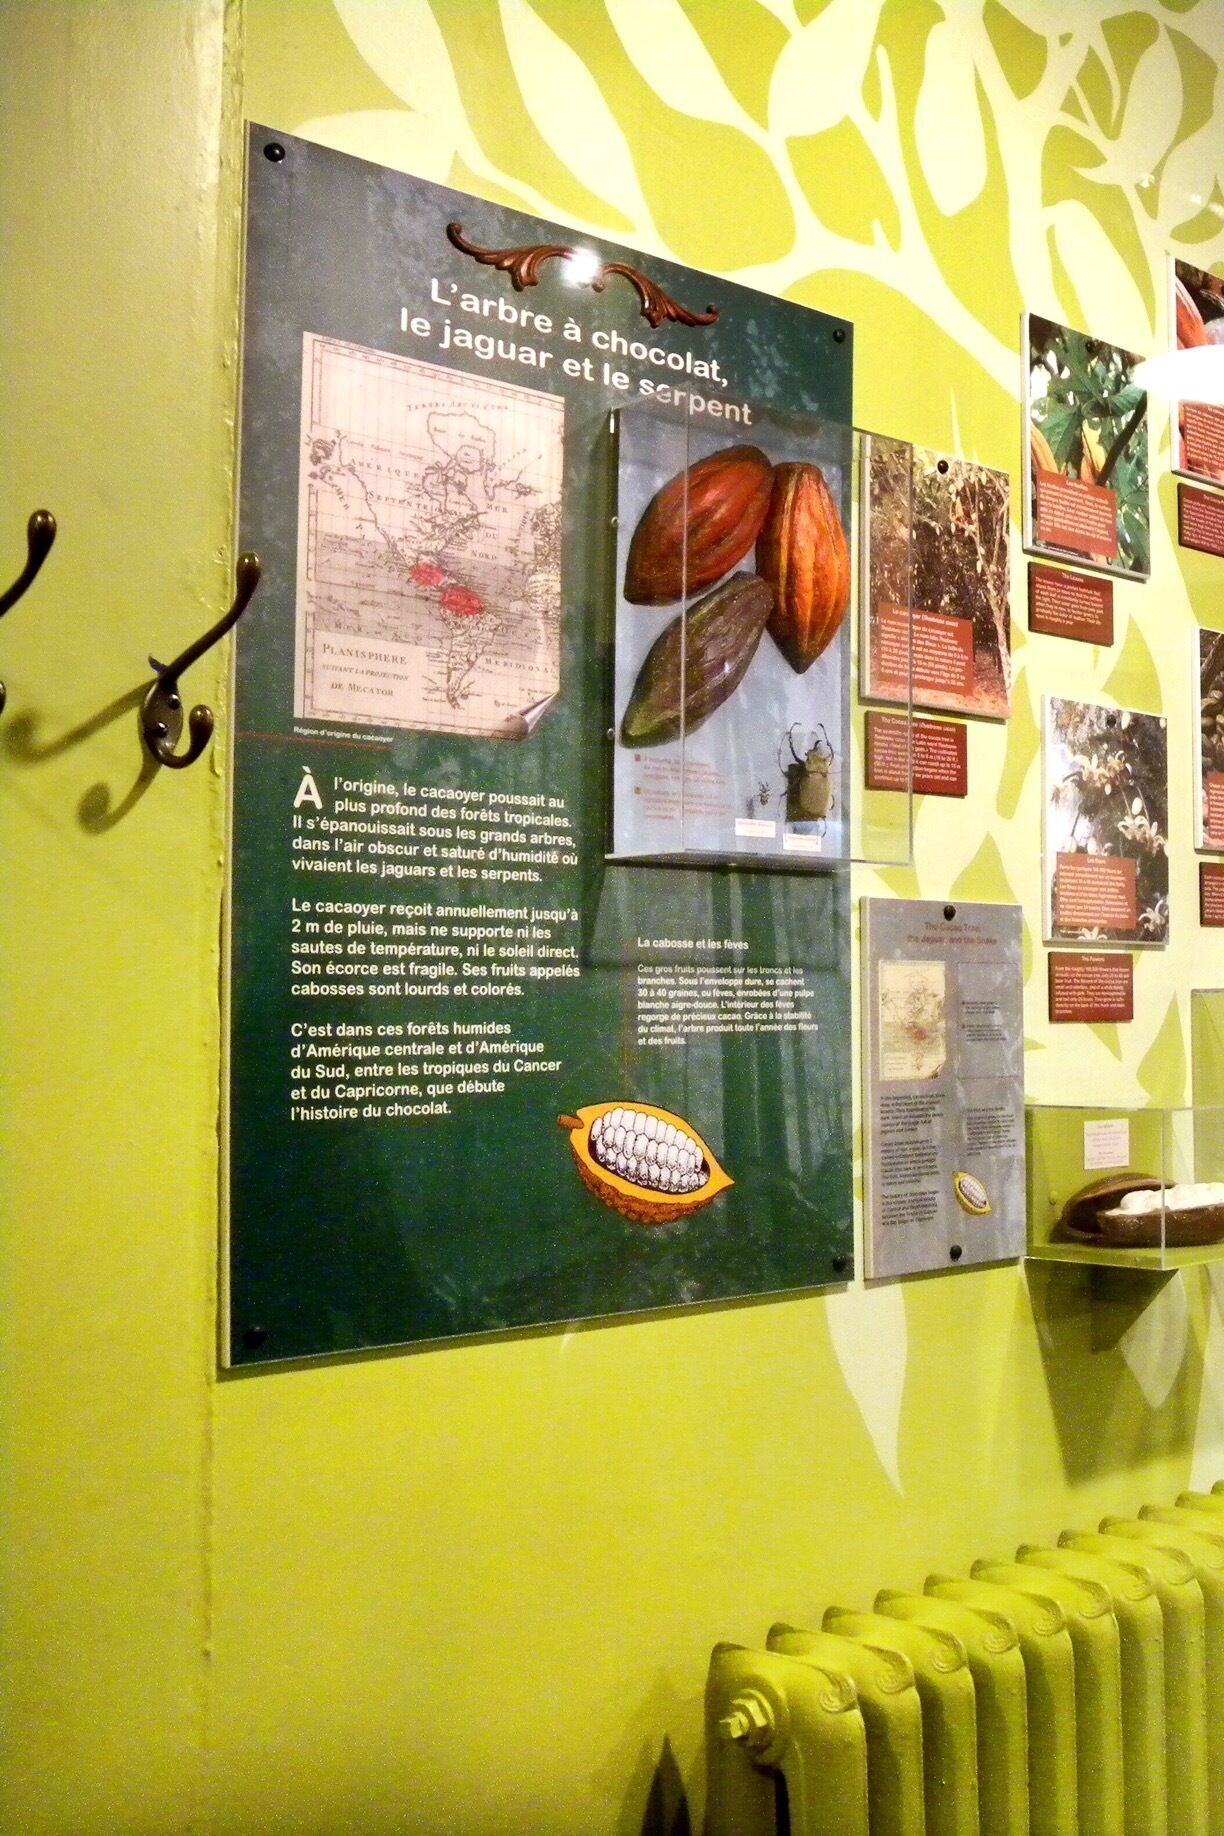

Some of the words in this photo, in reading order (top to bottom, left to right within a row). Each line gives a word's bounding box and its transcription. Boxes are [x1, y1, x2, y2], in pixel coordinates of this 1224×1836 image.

[430, 277, 552, 333] L'arbre
[562, 316, 581, 342] à
[592, 330, 728, 388] chocolat,
[400, 306, 430, 336] le
[439, 319, 552, 368] jaguar
[562, 357, 594, 382] et
[603, 363, 630, 390] le
[638, 380, 752, 425] serpent
[322, 643, 407, 664] PLANISPHERE
[294, 726, 318, 735] Région
[319, 729, 350, 738] d'origine
[362, 734, 393, 742] cacaoyer
[293, 766, 322, 810] À
[334, 776, 398, 797] l'origine,
[403, 782, 416, 796] le
[420, 787, 485, 803] cacaoyer
[488, 793, 545, 806] poussait
[548, 798, 564, 808] au
[334, 798, 366, 813] plus
[370, 802, 426, 816] profond
[431, 805, 456, 818] des
[460, 806, 500, 822] forêts
[504, 810, 572, 827] tropicales.
[292, 814, 302, 828] Il
[306, 816, 416, 835] s'épanouissait
[419, 826, 452, 838] sous
[455, 825, 476, 839] les
[480, 830, 526, 843] grands
[530, 832, 575, 848] arbres,
[292, 836, 330, 850] dans
[334, 838, 364, 852] l'air
[368, 840, 419, 855] obscur
[420, 844, 438, 856] et
[440, 845, 485, 860] saturé
[488, 847, 558, 863] d'humidité
[562, 852, 577, 864] où
[292, 856, 352, 872] vivaient
[356, 859, 377, 873] les
[380, 861, 435, 878] jaguars
[440, 864, 454, 877] et
[457, 865, 477, 878] les
[481, 869, 542, 882] serpents.
[292, 897, 310, 911] Le
[315, 902, 386, 916] cacaoyer
[390, 902, 432, 918] reçoit
[436, 904, 528, 918] annuellement
[530, 907, 578, 922] jusqu'à
[292, 918, 300, 932] 2
[306, 922, 319, 932] m
[324, 920, 342, 933] de
[348, 920, 387, 936] pluie,
[392, 922, 426, 935] mais
[430, 922, 447, 936] ne
[452, 925, 513, 939] supporte
[514, 925, 528, 938] ni
[532, 925, 551, 938] les
[291, 940, 342, 953] sautes
[347, 941, 366, 954] de
[370, 941, 462, 957] température,
[466, 943, 478, 956] ni
[483, 943, 494, 956] le
[499, 944, 533, 957] soleil
[536, 943, 578, 961] direct.
[637, 937, 650, 946] La
[652, 938, 693, 948] cabosse
[696, 939, 706, 949] et
[707, 938, 721, 948] les
[724, 939, 748, 950] fèves
[291, 960, 320, 974] Son
[326, 960, 378, 974] écorce
[382, 962, 405, 974] est
[408, 962, 457, 978] fragile.
[462, 962, 489, 977] Ses
[490, 963, 526, 976] fruits
[529, 964, 580, 979] appelés
[291, 981, 364, 994] cabosses
[368, 982, 401, 995] sont
[404, 982, 449, 995] lourds
[453, 982, 468, 994] et
[471, 982, 524, 995] colorés.
[291, 1023, 332, 1036] C'est
[336, 1022, 372, 1036] dans
[377, 1025, 402, 1035] ces
[406, 1022, 449, 1034] forêts
[453, 1021, 510, 1034] humides
[290, 1043, 380, 1059] d'Amérique
[384, 1041, 444, 1055] centrale
[448, 1041, 462, 1054] et
[465, 1040, 544, 1055] d'Amérique
[290, 1065, 310, 1078] du
[315, 1063, 349, 1079] Sud,
[354, 1063, 393, 1076] entre
[398, 1062, 418, 1075] les
[422, 1061, 488, 1077] tropiques
[492, 1059, 509, 1072] du
[513, 1058, 562, 1071] Cancer
[290, 1086, 306, 1099] et
[310, 1085, 330, 1098] du
[334, 1083, 422, 1100] Capricorne,
[426, 1084, 453, 1097] que
[457, 1079, 505, 1092] débute
[291, 1105, 358, 1120] l'histoire
[362, 1104, 381, 1117] du
[385, 1100, 451, 1116] chocolat.
